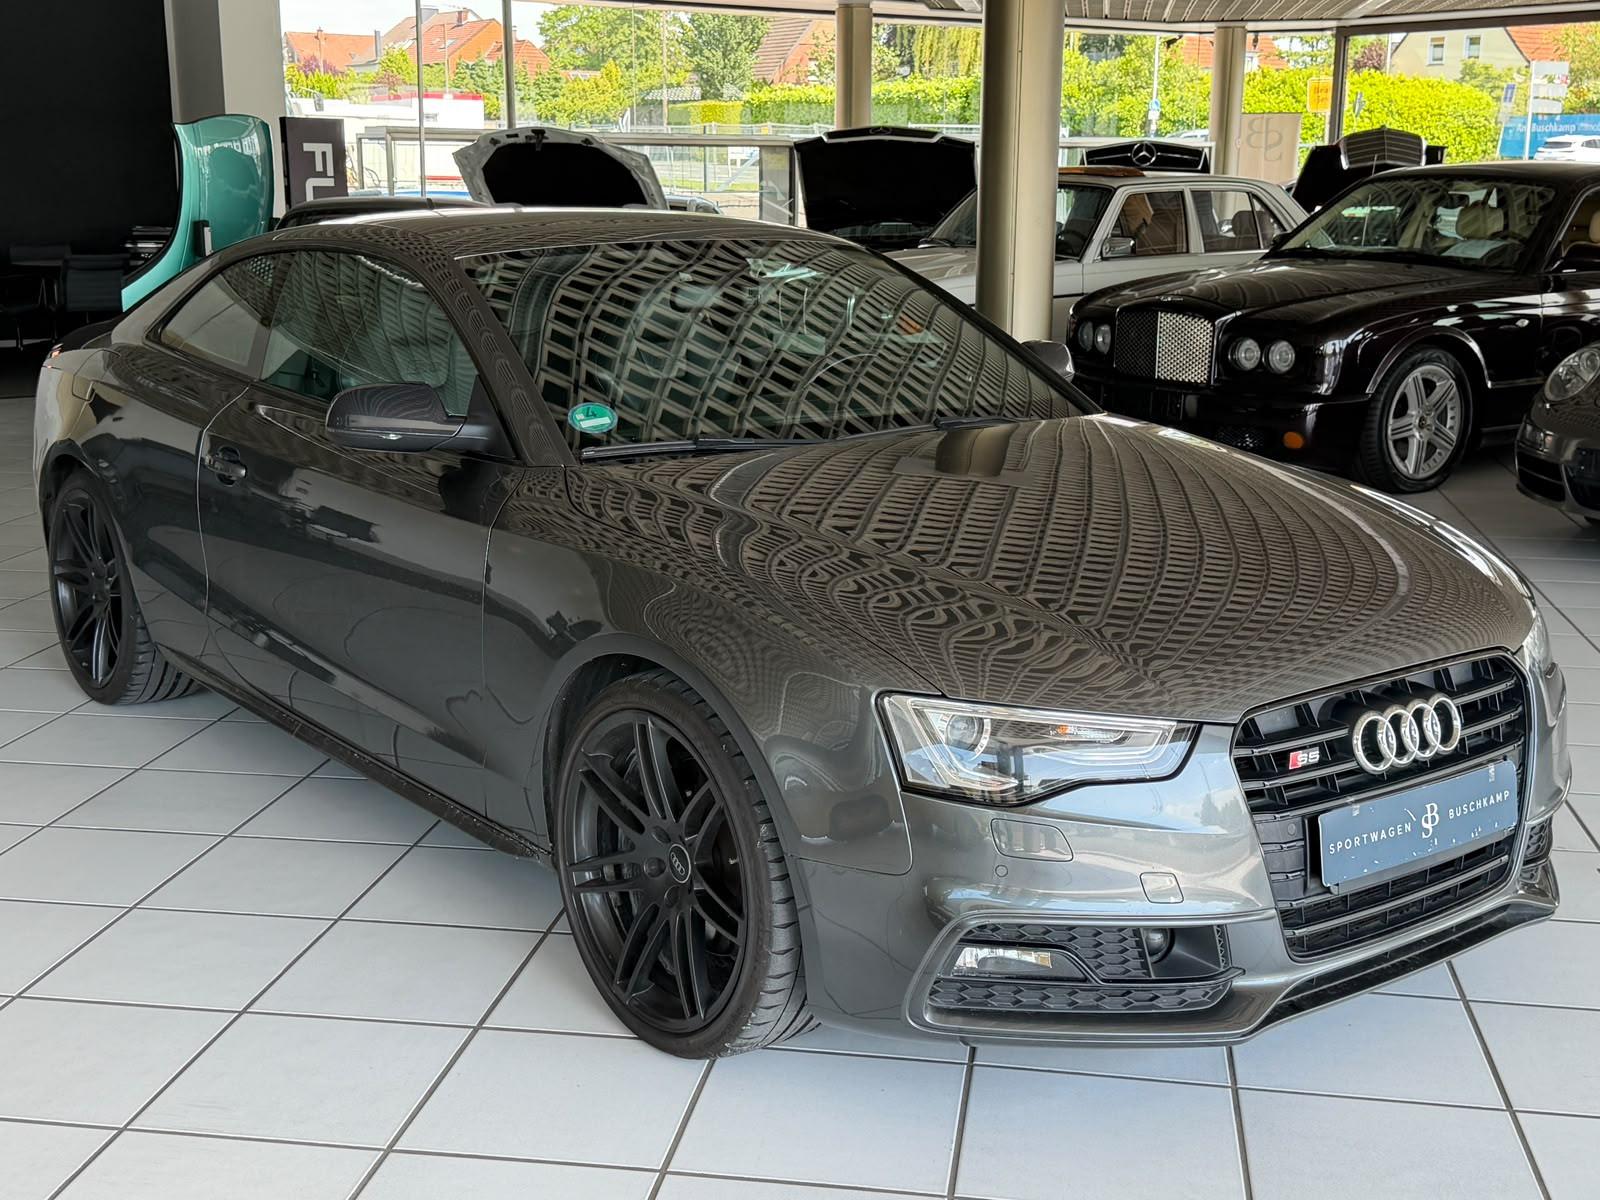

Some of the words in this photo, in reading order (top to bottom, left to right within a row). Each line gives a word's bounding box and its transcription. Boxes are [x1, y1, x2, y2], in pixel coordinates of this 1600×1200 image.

[1295, 750, 1320, 766] S5
[1329, 822, 1412, 855] SPORTWAGEN
[1448, 790, 1510, 820] BUSCHKAMP
